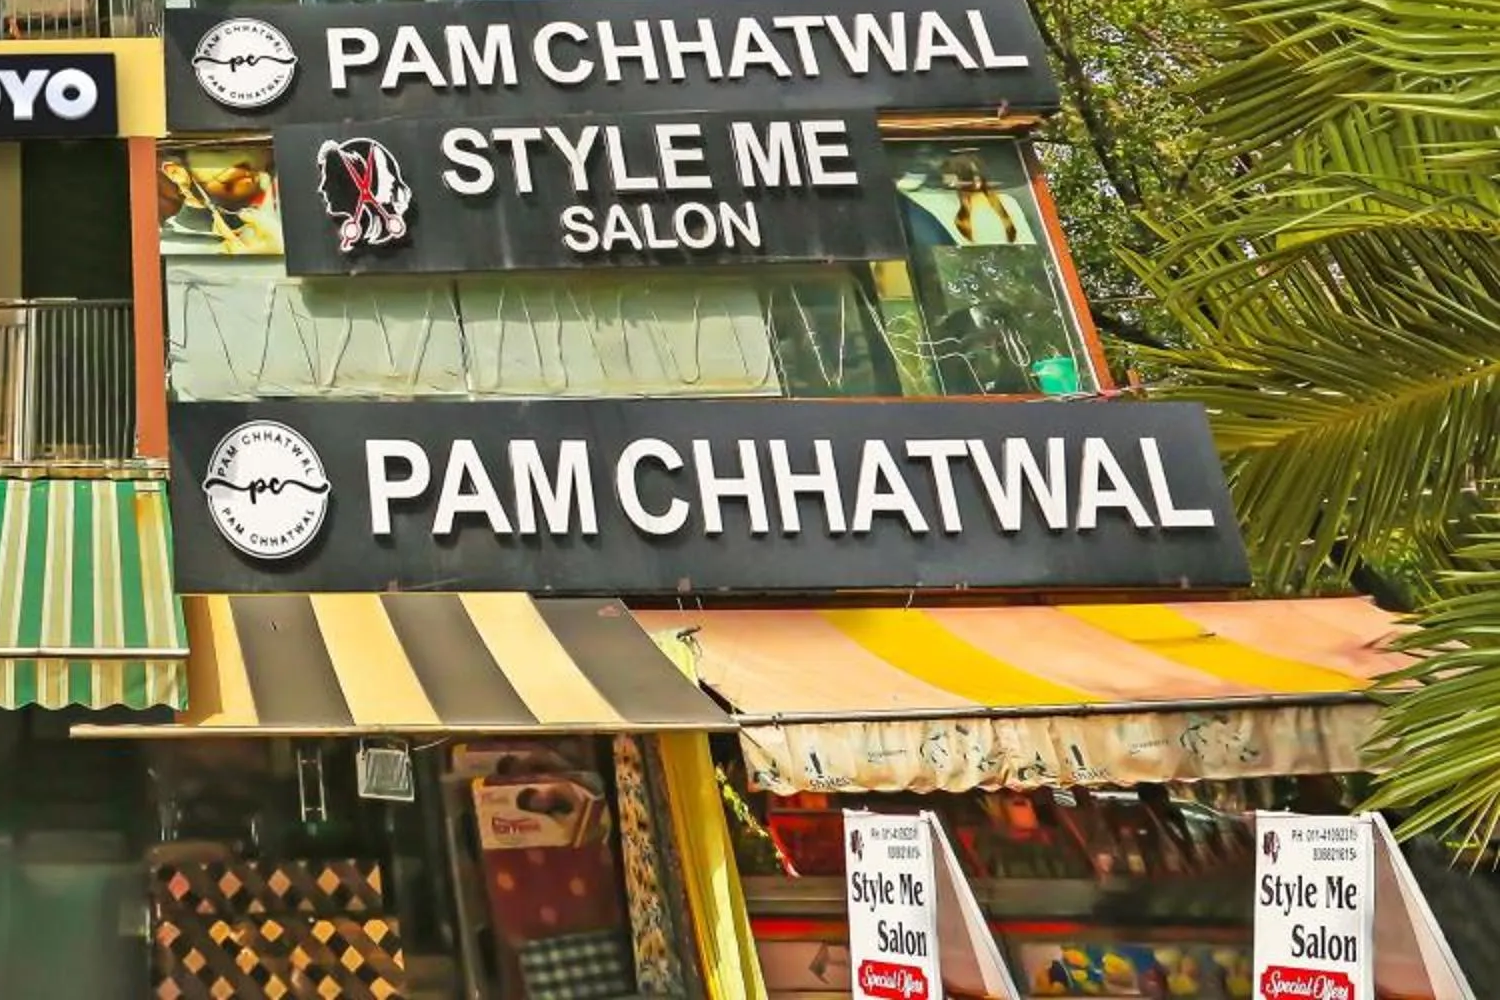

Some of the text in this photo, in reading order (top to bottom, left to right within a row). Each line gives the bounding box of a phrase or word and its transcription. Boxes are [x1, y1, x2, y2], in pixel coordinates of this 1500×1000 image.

[327, 10, 1029, 90] PAM CHHATWAL
[441, 120, 858, 194] STYLE ME
[562, 201, 761, 251] SALON
[217, 430, 316, 477] PAM CHHATWAL
[365, 437, 1216, 535] PAM CHHATWAL
[222, 506, 316, 547] PAM CHHATWAL
[851, 871, 924, 912] Style Me
[1260, 874, 1357, 917] Style Me
[877, 919, 927, 957] Salon
[1291, 923, 1357, 963] Salon
[863, 964, 896, 992] Special
[1265, 970, 1313, 998] Special
